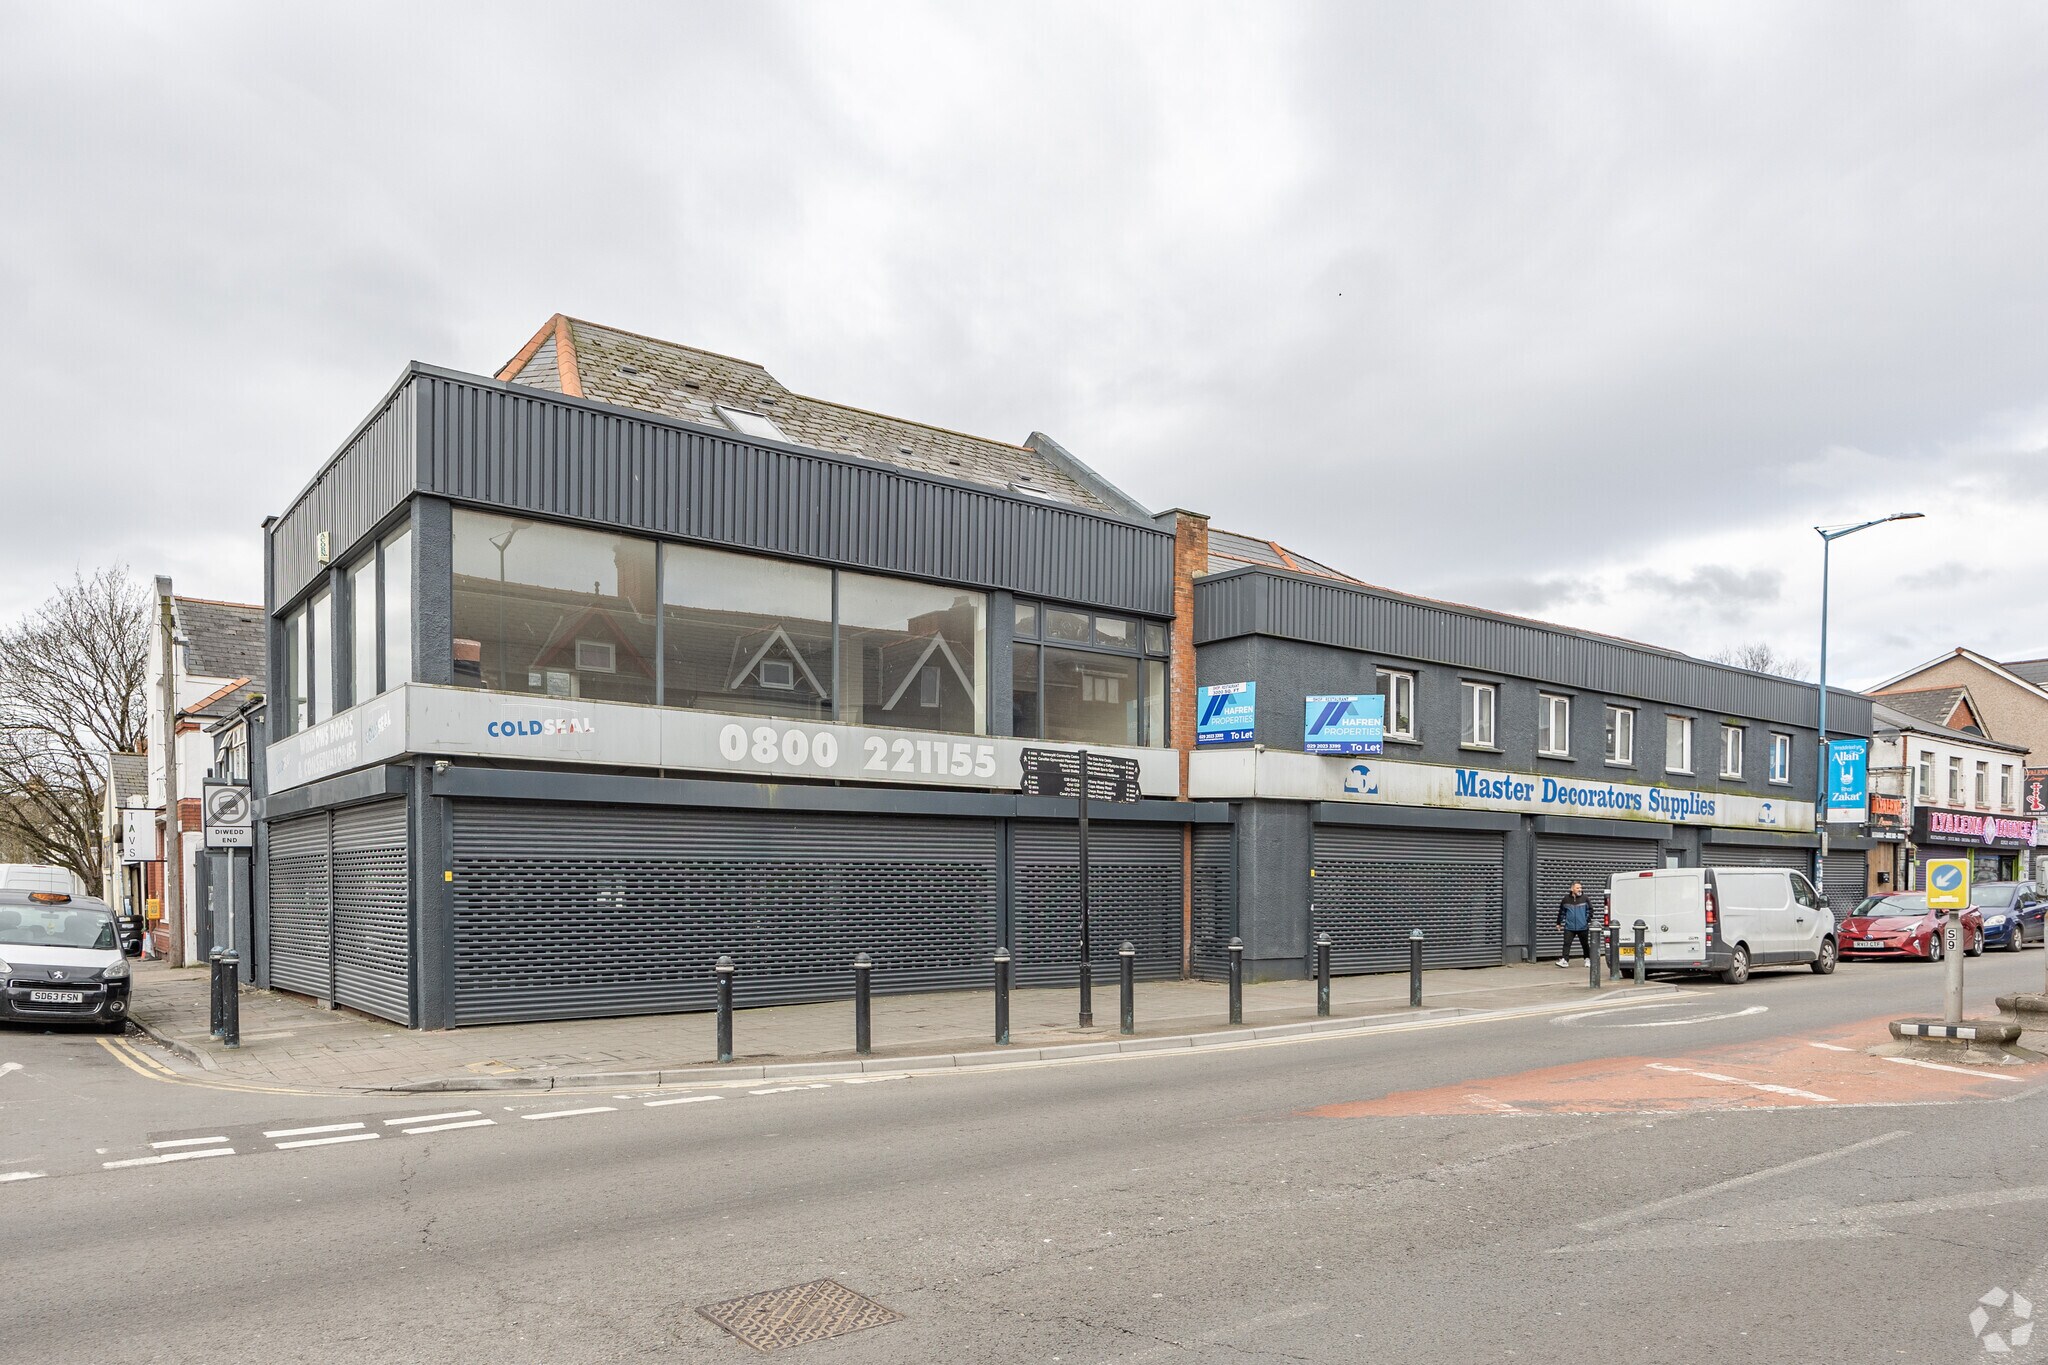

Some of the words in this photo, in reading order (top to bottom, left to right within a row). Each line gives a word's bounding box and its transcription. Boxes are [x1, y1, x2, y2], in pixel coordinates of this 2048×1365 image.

[1224, 706, 1253, 715] HAFREN
[488, 718, 594, 737] COLDSEAL
[1212, 715, 1253, 725] PROPERTIES
[300, 725, 329, 756] WINDOWS
[330, 714, 354, 744] DOORS
[304, 741, 357, 777] CONSERVATORIES
[719, 724, 838, 768] 0800
[863, 736, 996, 778] 221155
[1832, 748, 1864, 765] Allah
[1455, 769, 1534, 801] Master
[1541, 778, 1641, 812] Decorators
[1649, 787, 1716, 820] Supplies
[1832, 792, 1862, 801] Zakat
[1995, 819, 2031, 839] LOUNGE
[1948, 930, 1955, 938] S
[1948, 941, 1954, 949] 9
